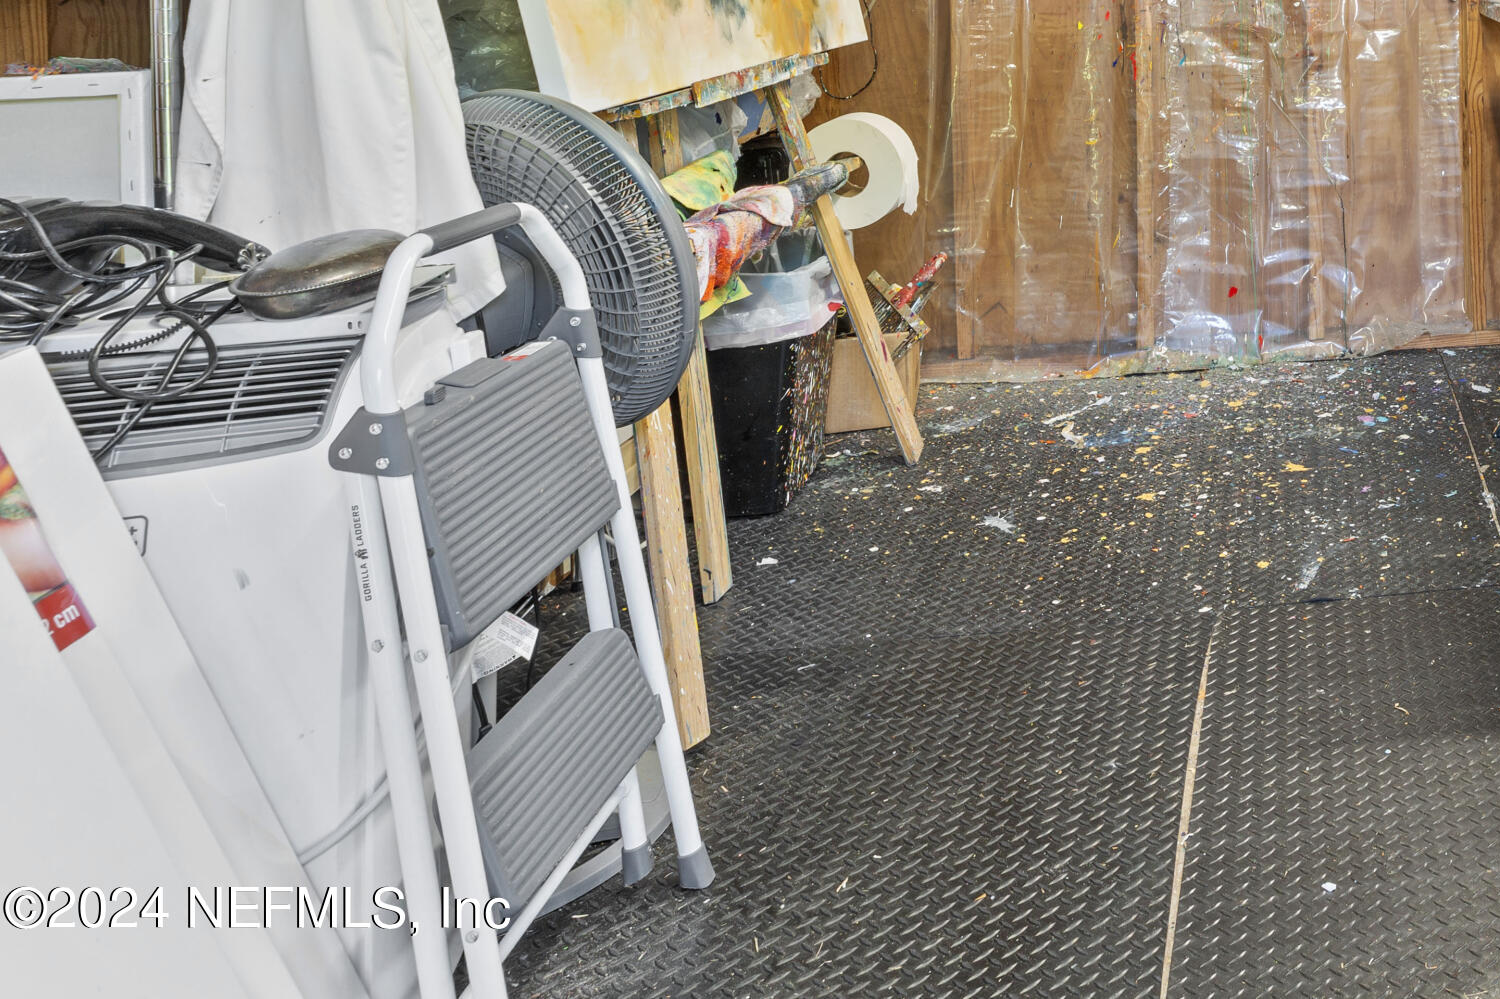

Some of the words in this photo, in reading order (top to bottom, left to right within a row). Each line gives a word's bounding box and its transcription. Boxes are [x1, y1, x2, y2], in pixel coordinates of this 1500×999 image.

[351, 504, 364, 547] LADDERS
[360, 562, 373, 602] GORILLA
[53, 604, 81, 628] cm
